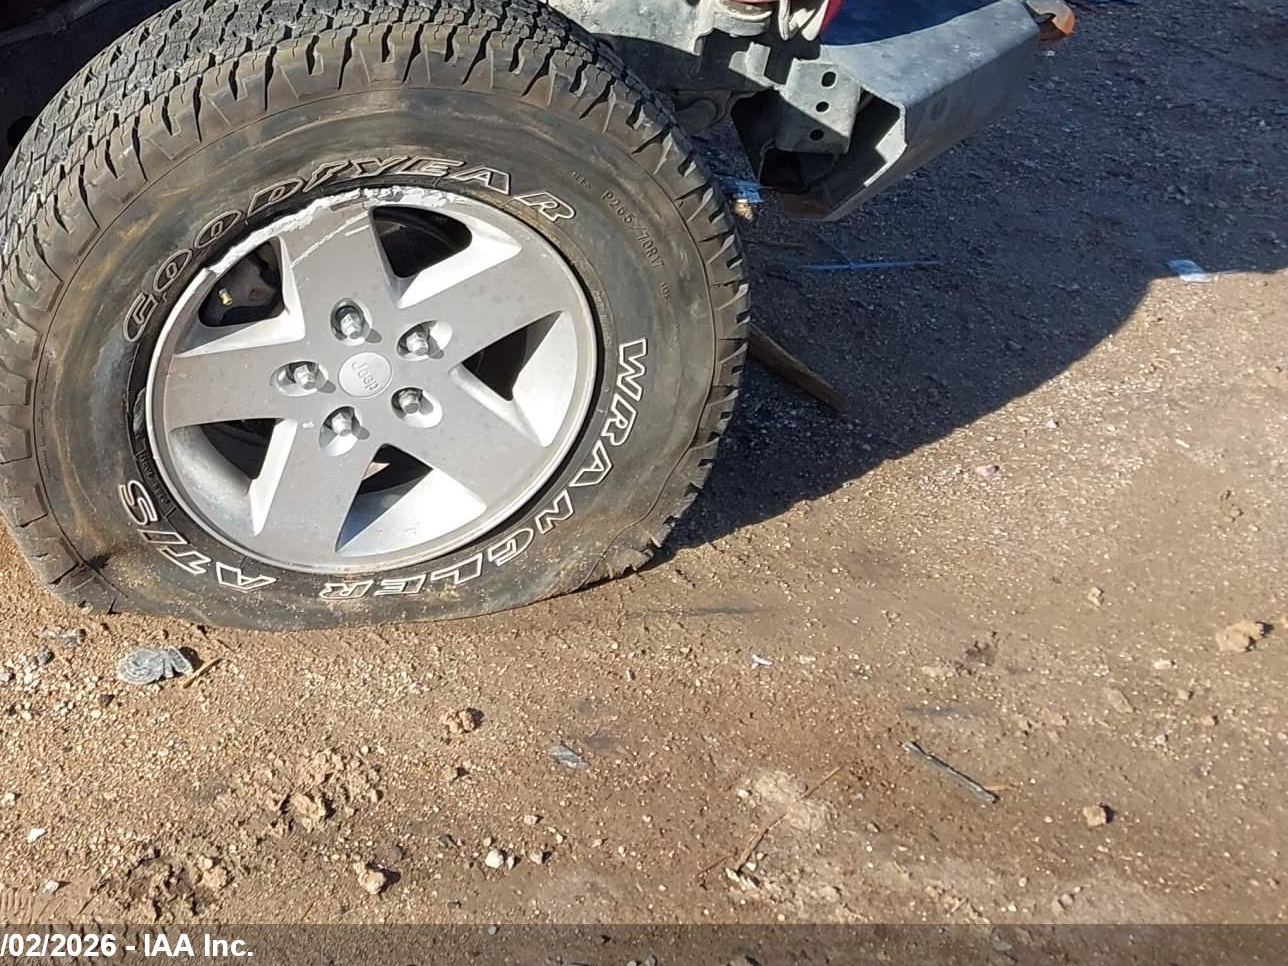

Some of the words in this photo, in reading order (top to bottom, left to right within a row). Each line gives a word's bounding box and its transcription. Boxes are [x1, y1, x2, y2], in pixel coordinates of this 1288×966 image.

[122, 154, 576, 342] GOODYEAR
[318, 337, 648, 601] WRANGLER
[352, 361, 379, 391] Jeep
